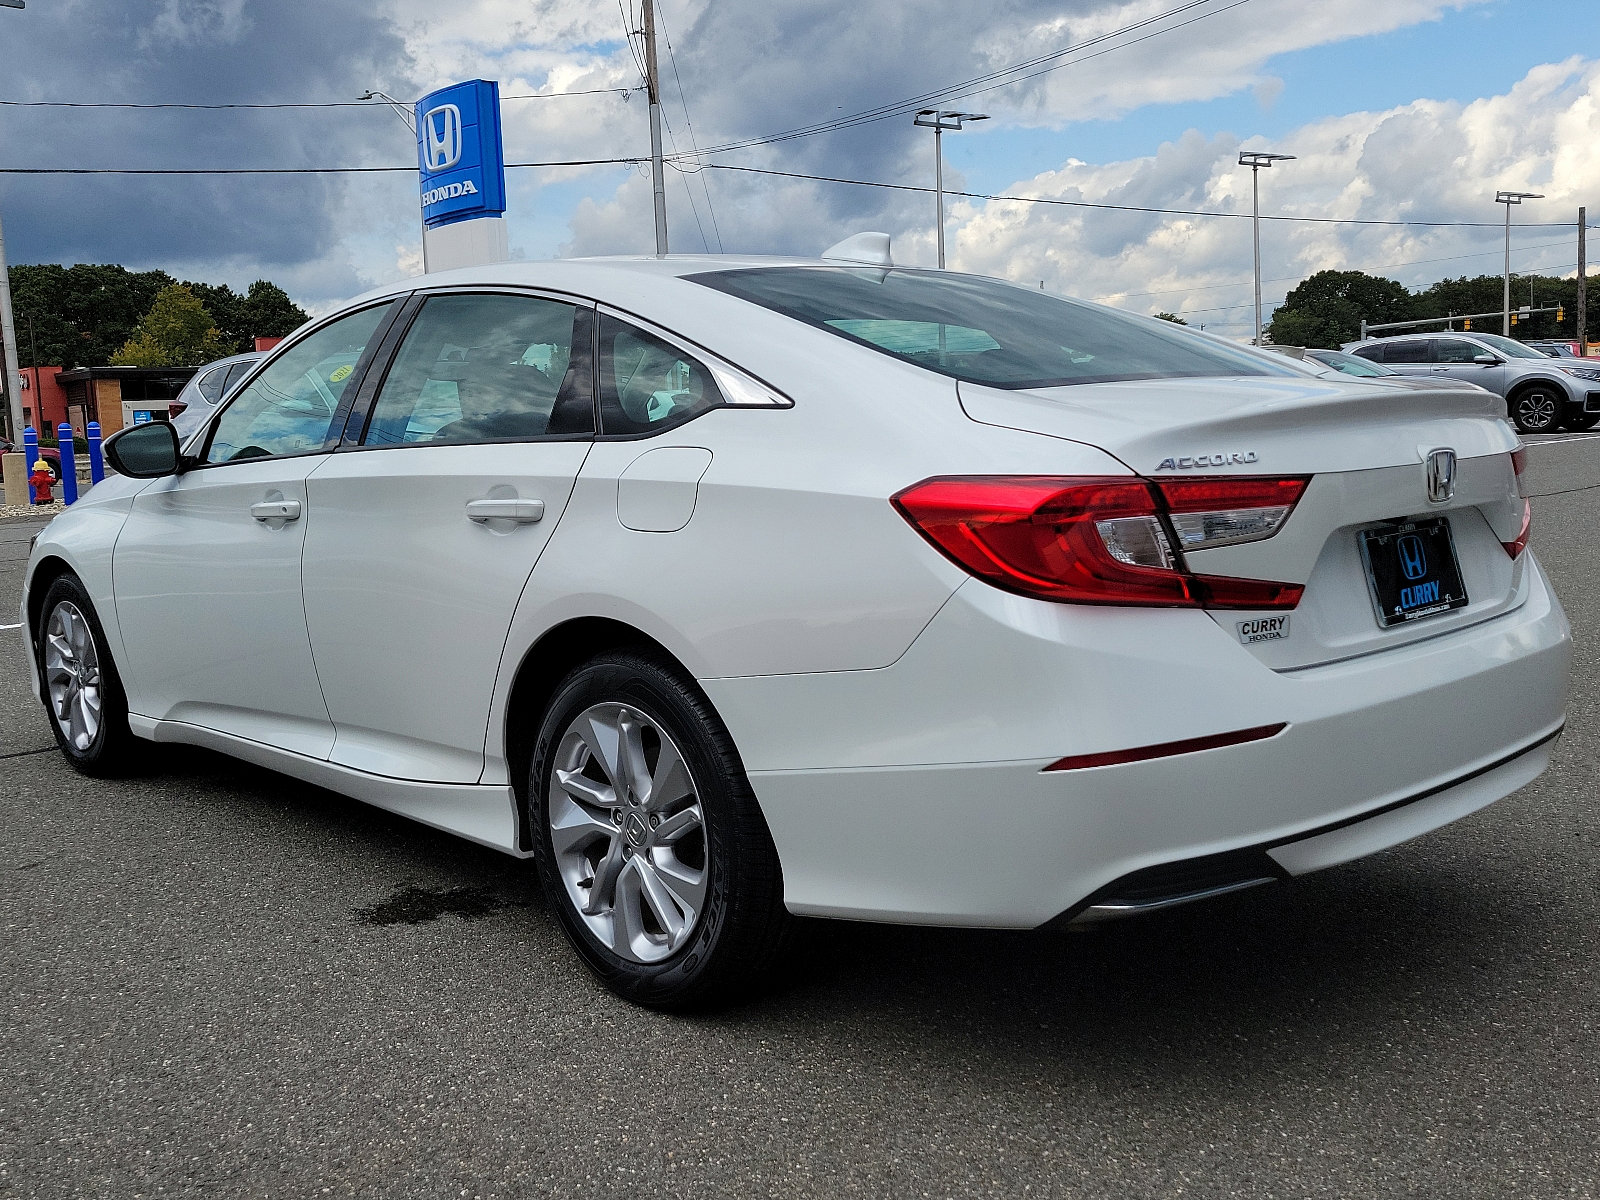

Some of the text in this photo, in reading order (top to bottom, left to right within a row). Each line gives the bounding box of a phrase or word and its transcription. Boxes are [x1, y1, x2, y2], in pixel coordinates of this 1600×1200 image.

[421, 180, 478, 207] HONDA
[1154, 451, 1258, 471] ACCORD
[1401, 580, 1440, 609] CURRY
[1242, 616, 1285, 635] CURRY
[1249, 631, 1281, 642] HONDA
